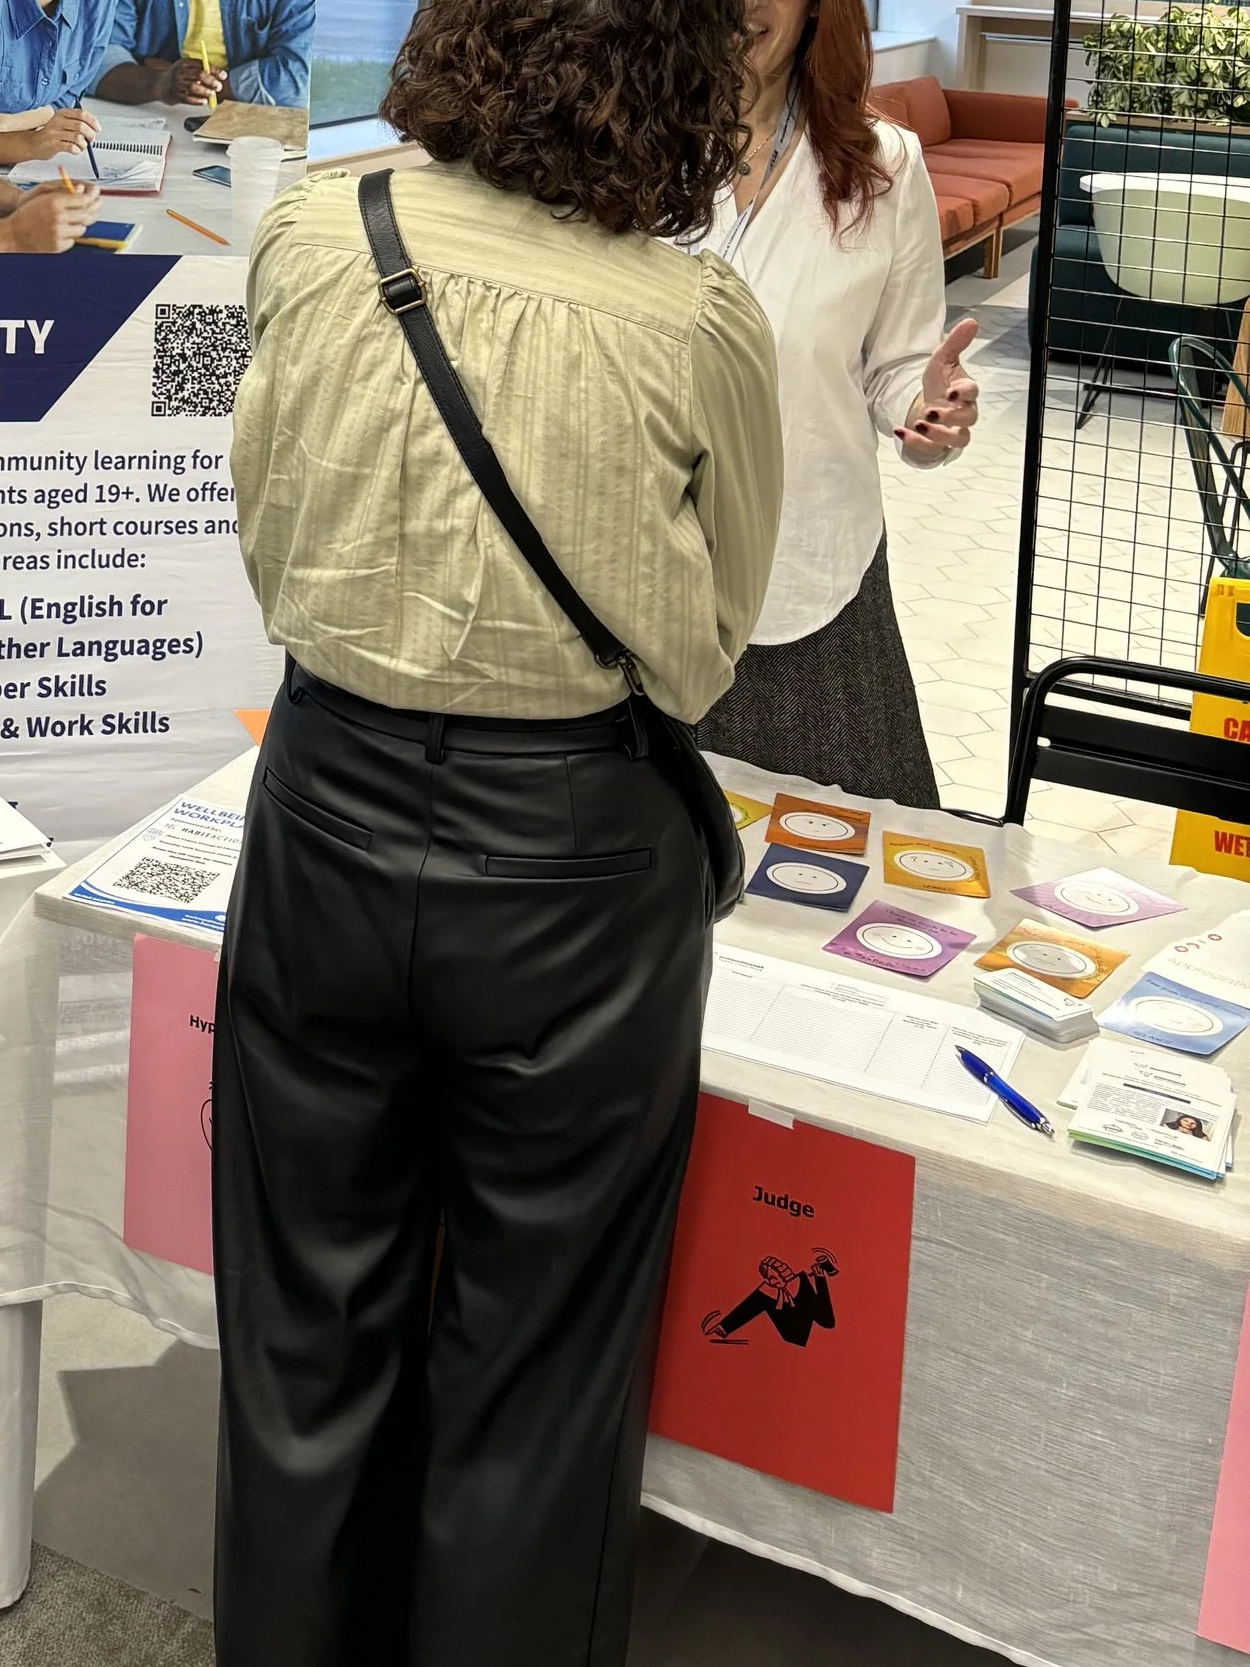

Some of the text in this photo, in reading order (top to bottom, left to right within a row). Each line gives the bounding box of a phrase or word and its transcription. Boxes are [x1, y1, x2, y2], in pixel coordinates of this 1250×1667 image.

[94, 449, 186, 475] learning
[191, 449, 224, 470] for
[33, 483, 88, 510] aged
[95, 484, 141, 503] 19+.
[147, 483, 180, 503] We
[47, 516, 107, 537] short
[113, 519, 198, 535] courses
[56, 547, 146, 569] include:
[20, 595, 123, 625] (English
[130, 593, 168, 617] for
[57, 630, 203, 663] Languages)
[37, 674, 107, 698] Skills
[0, 718, 20, 739] &
[26, 713, 95, 738] Work
[101, 711, 170, 735] Skills
[1224, 717, 1250, 742] CA
[181, 828, 242, 844] HABITACTIO
[190, 1014, 215, 1034] Hyp
[753, 1185, 814, 1218] Judge
